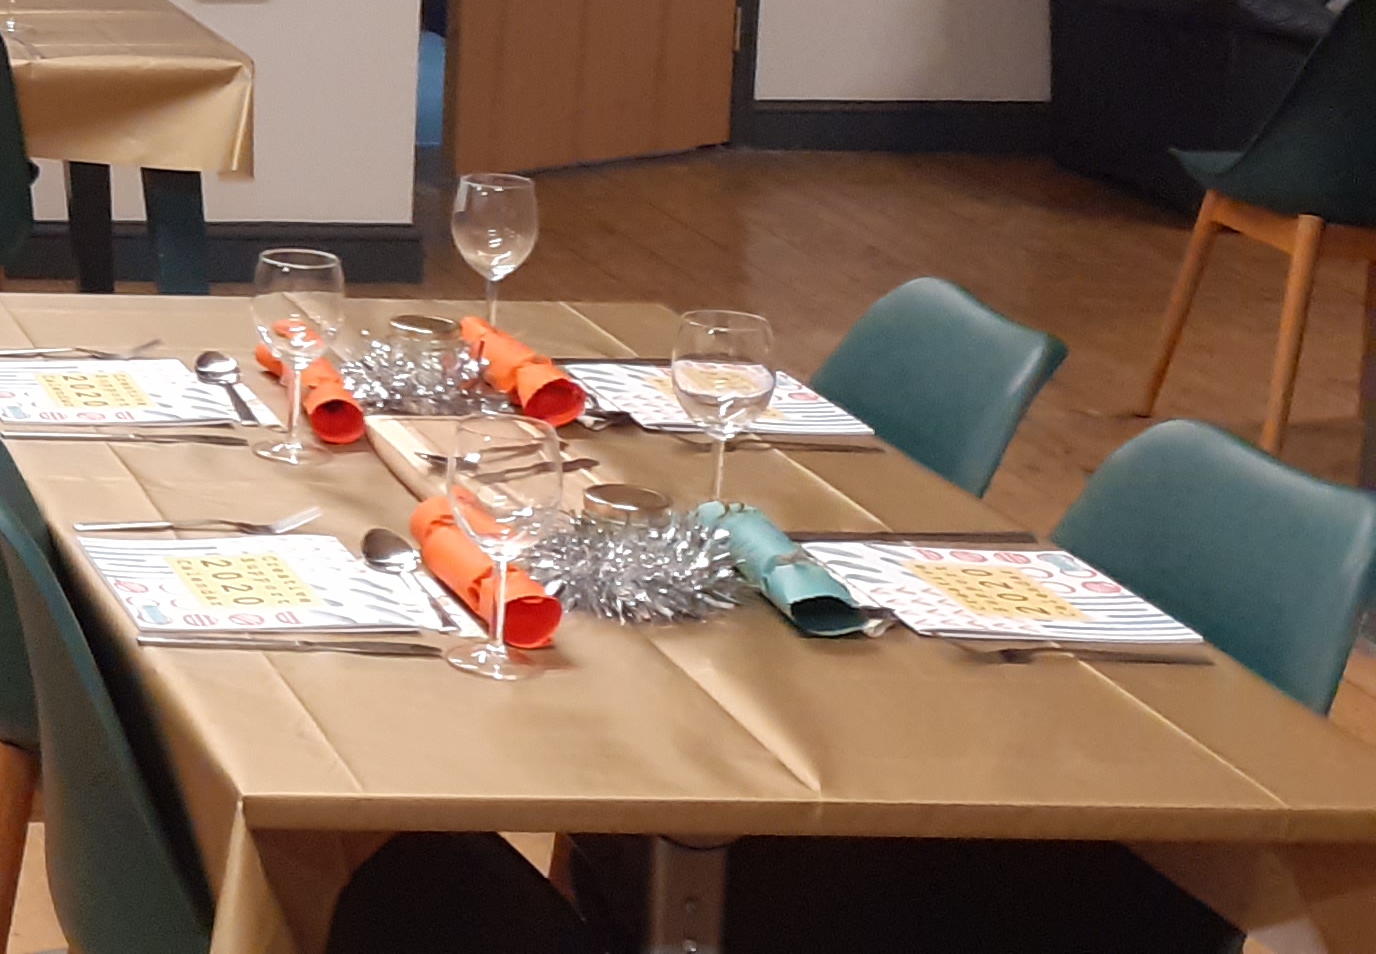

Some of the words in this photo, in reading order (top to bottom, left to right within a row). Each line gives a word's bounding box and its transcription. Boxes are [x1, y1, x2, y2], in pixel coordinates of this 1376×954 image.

[62, 375, 109, 407] 2020
[200, 559, 264, 605] 2020
[961, 568, 1051, 615] 2020
